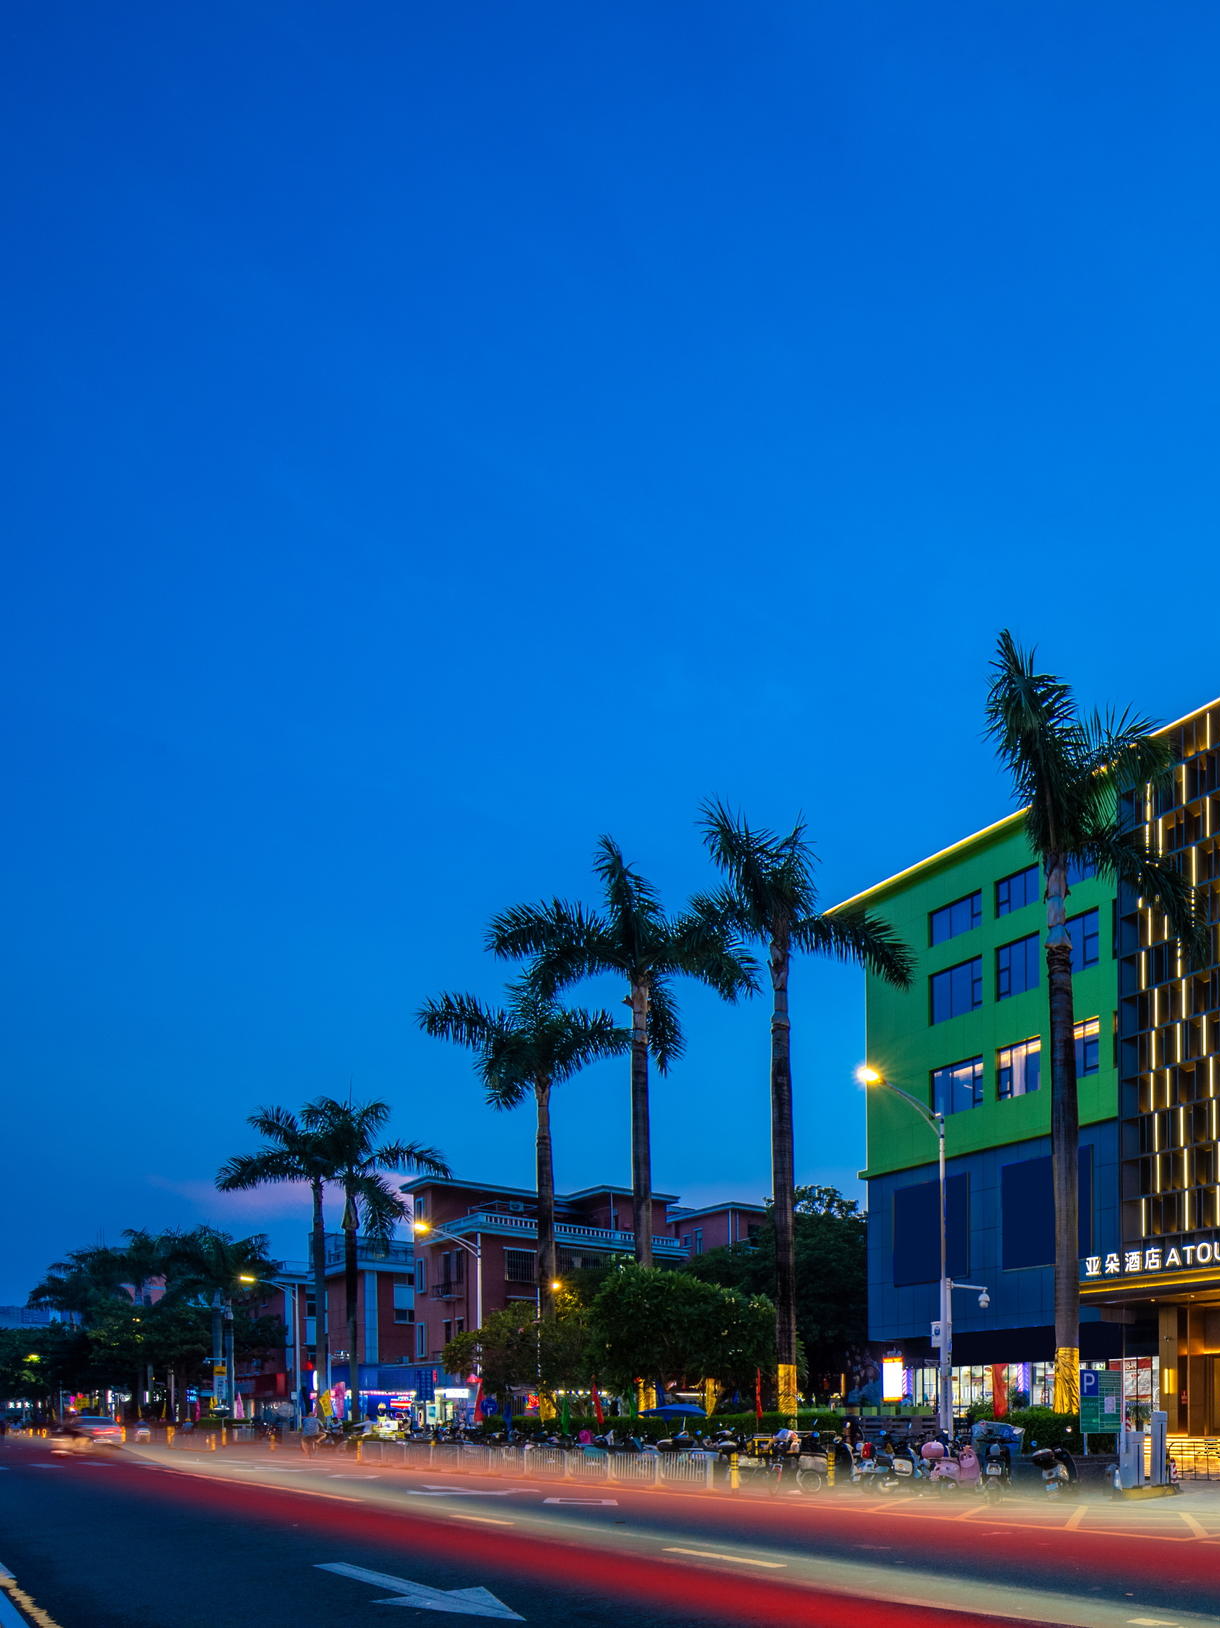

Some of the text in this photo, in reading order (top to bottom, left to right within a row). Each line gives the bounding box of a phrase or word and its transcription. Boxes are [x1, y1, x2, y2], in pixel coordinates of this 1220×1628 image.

[1085, 1247, 1163, 1277] 亚朵酒店
[1083, 1373, 1096, 1394] P
